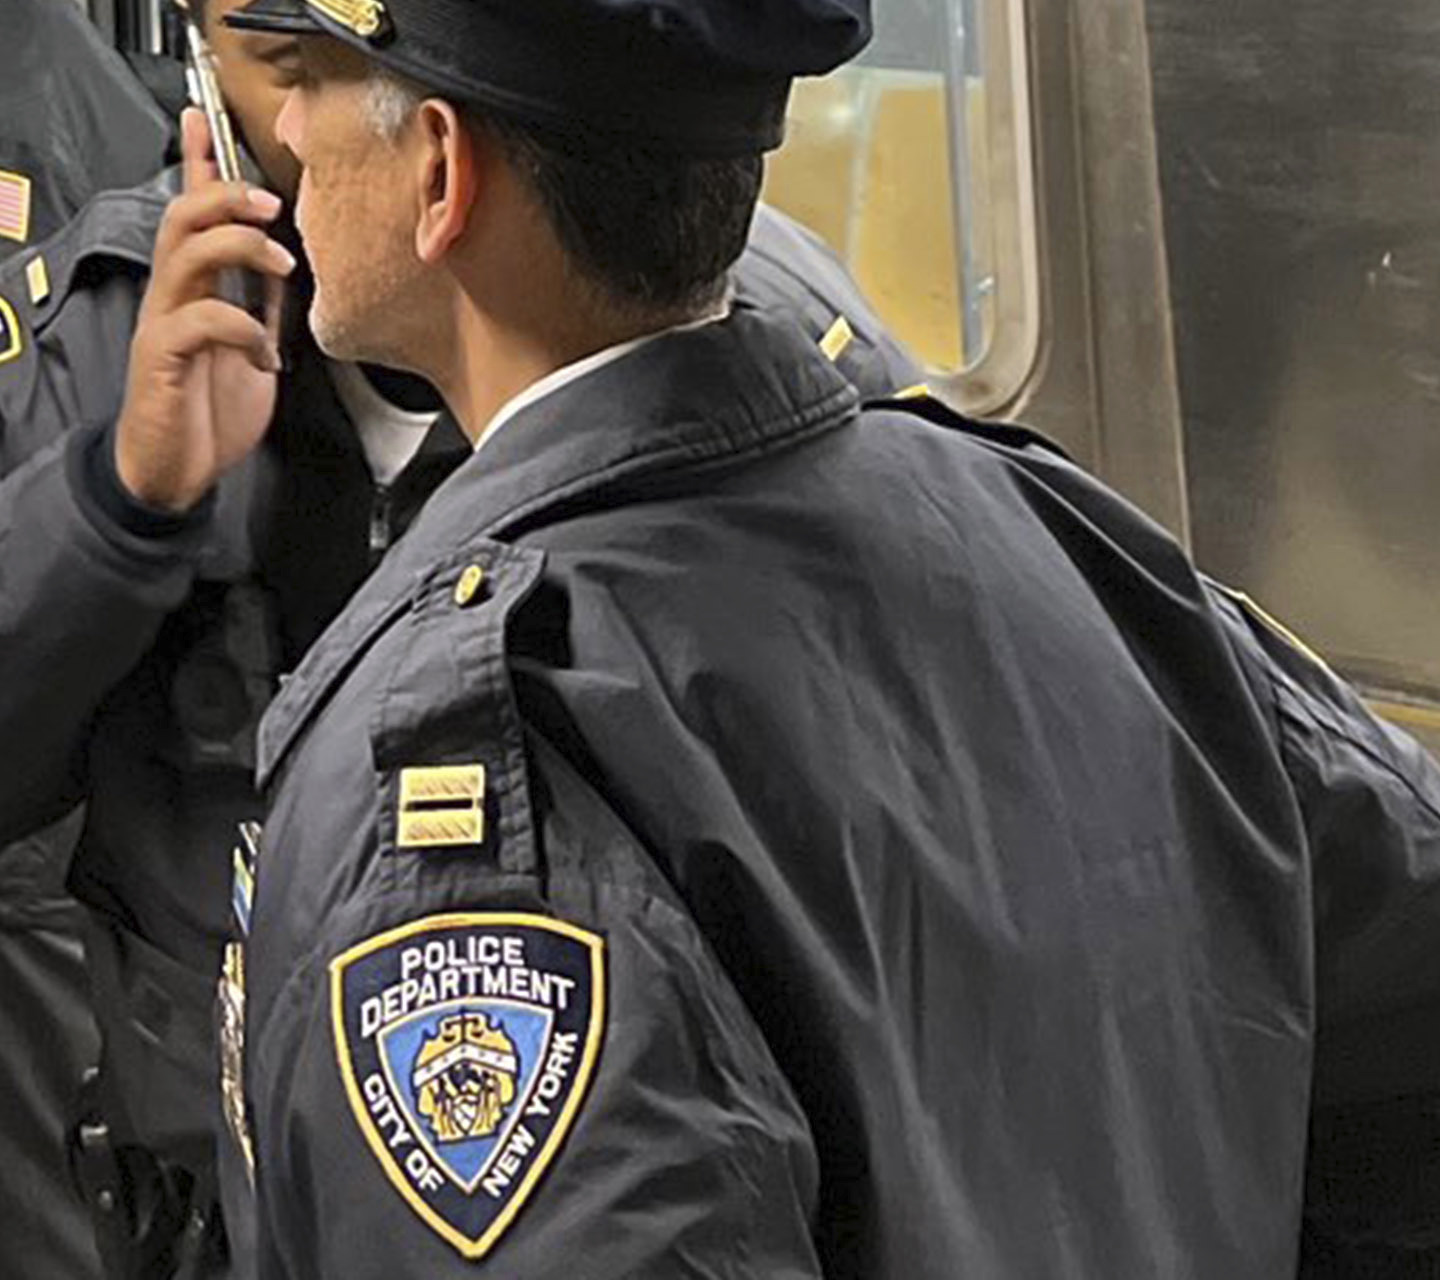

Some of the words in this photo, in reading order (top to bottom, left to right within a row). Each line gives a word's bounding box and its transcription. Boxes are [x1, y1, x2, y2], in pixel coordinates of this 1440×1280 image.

[360, 965, 576, 1038] DEPARTMENT
[400, 935, 524, 980] POLICE
[362, 1072, 412, 1148] CITY
[405, 1148, 446, 1192] OF
[481, 1124, 537, 1198] NEW
[524, 1031, 579, 1117] YORK
